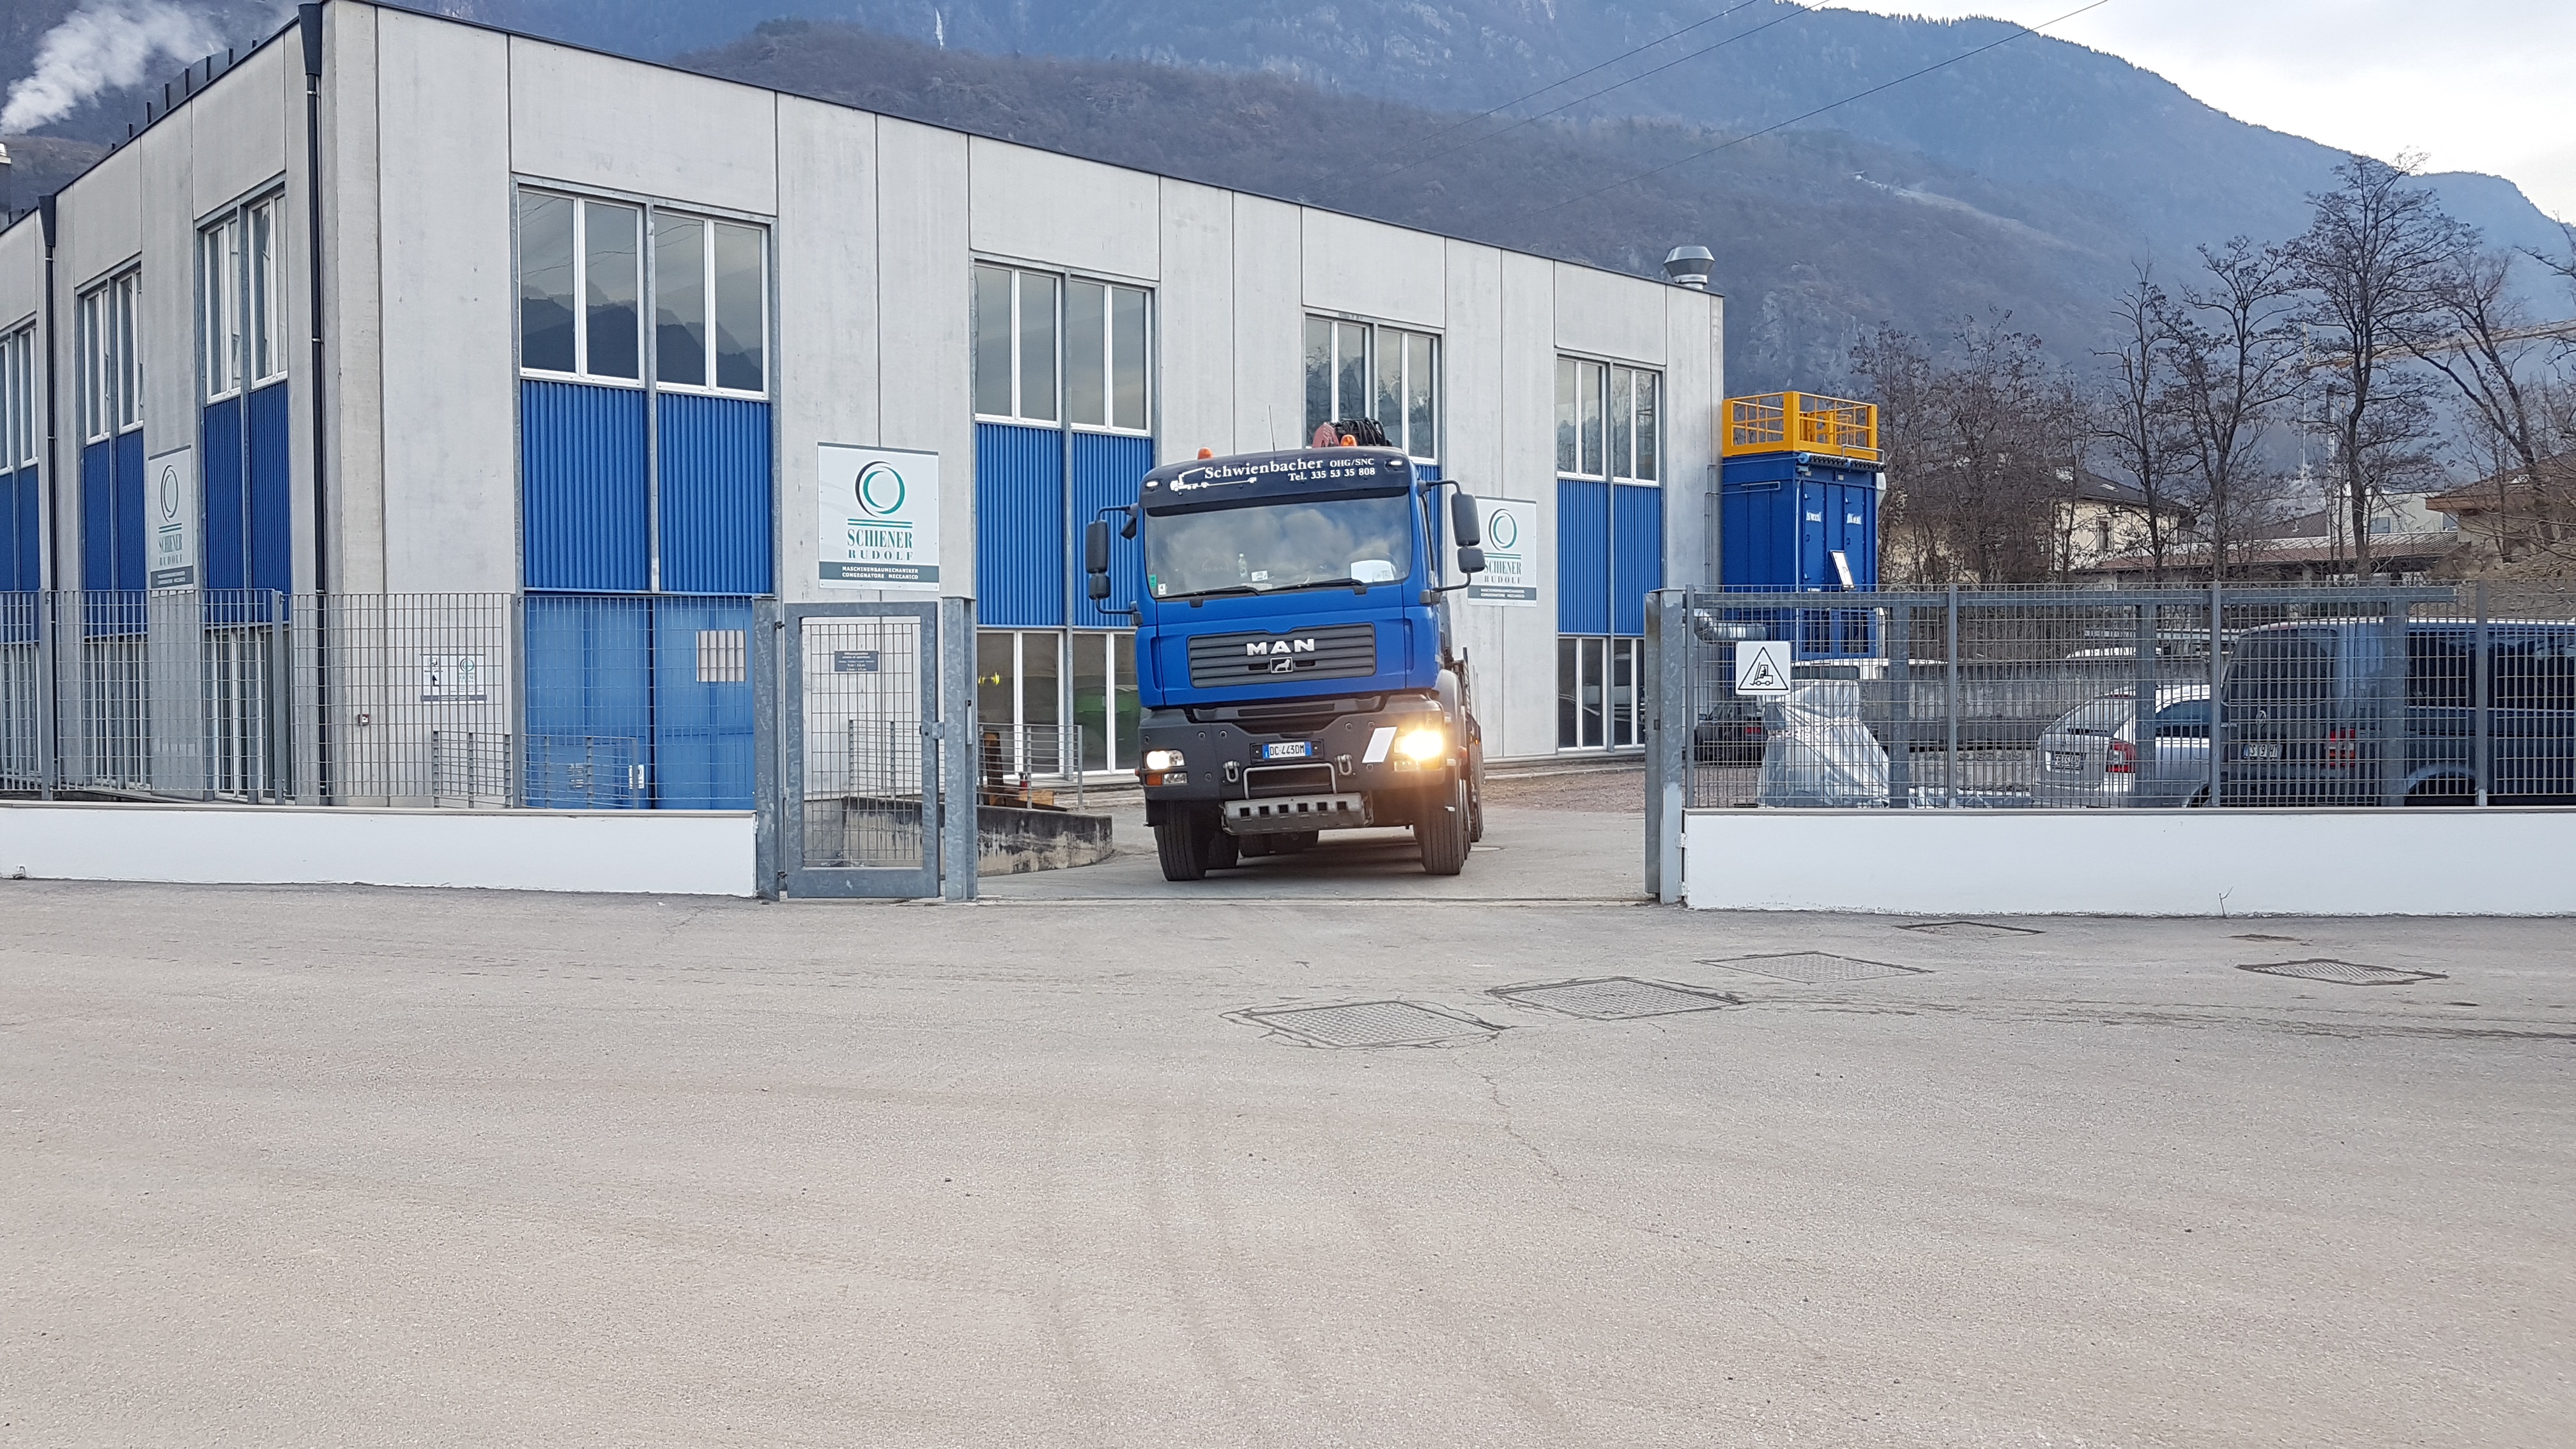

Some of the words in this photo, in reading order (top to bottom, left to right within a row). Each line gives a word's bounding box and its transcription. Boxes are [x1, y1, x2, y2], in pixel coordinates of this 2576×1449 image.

[1204, 458, 1324, 479] Schwienbacher
[1330, 458, 1375, 468] OHG/SNC
[1287, 473, 1307, 481] Tel.
[1311, 470, 1326, 479] 335
[1330, 470, 1340, 478] 53
[1344, 468, 1355, 477] 35
[1358, 467, 1376, 476] 808
[847, 529, 913, 549] SCHIENER
[848, 549, 913, 561] RUDOLF
[1484, 560, 1522, 575] SCHIENER
[1484, 576, 1522, 584] RUDOLF
[1246, 638, 1315, 656] MAN
